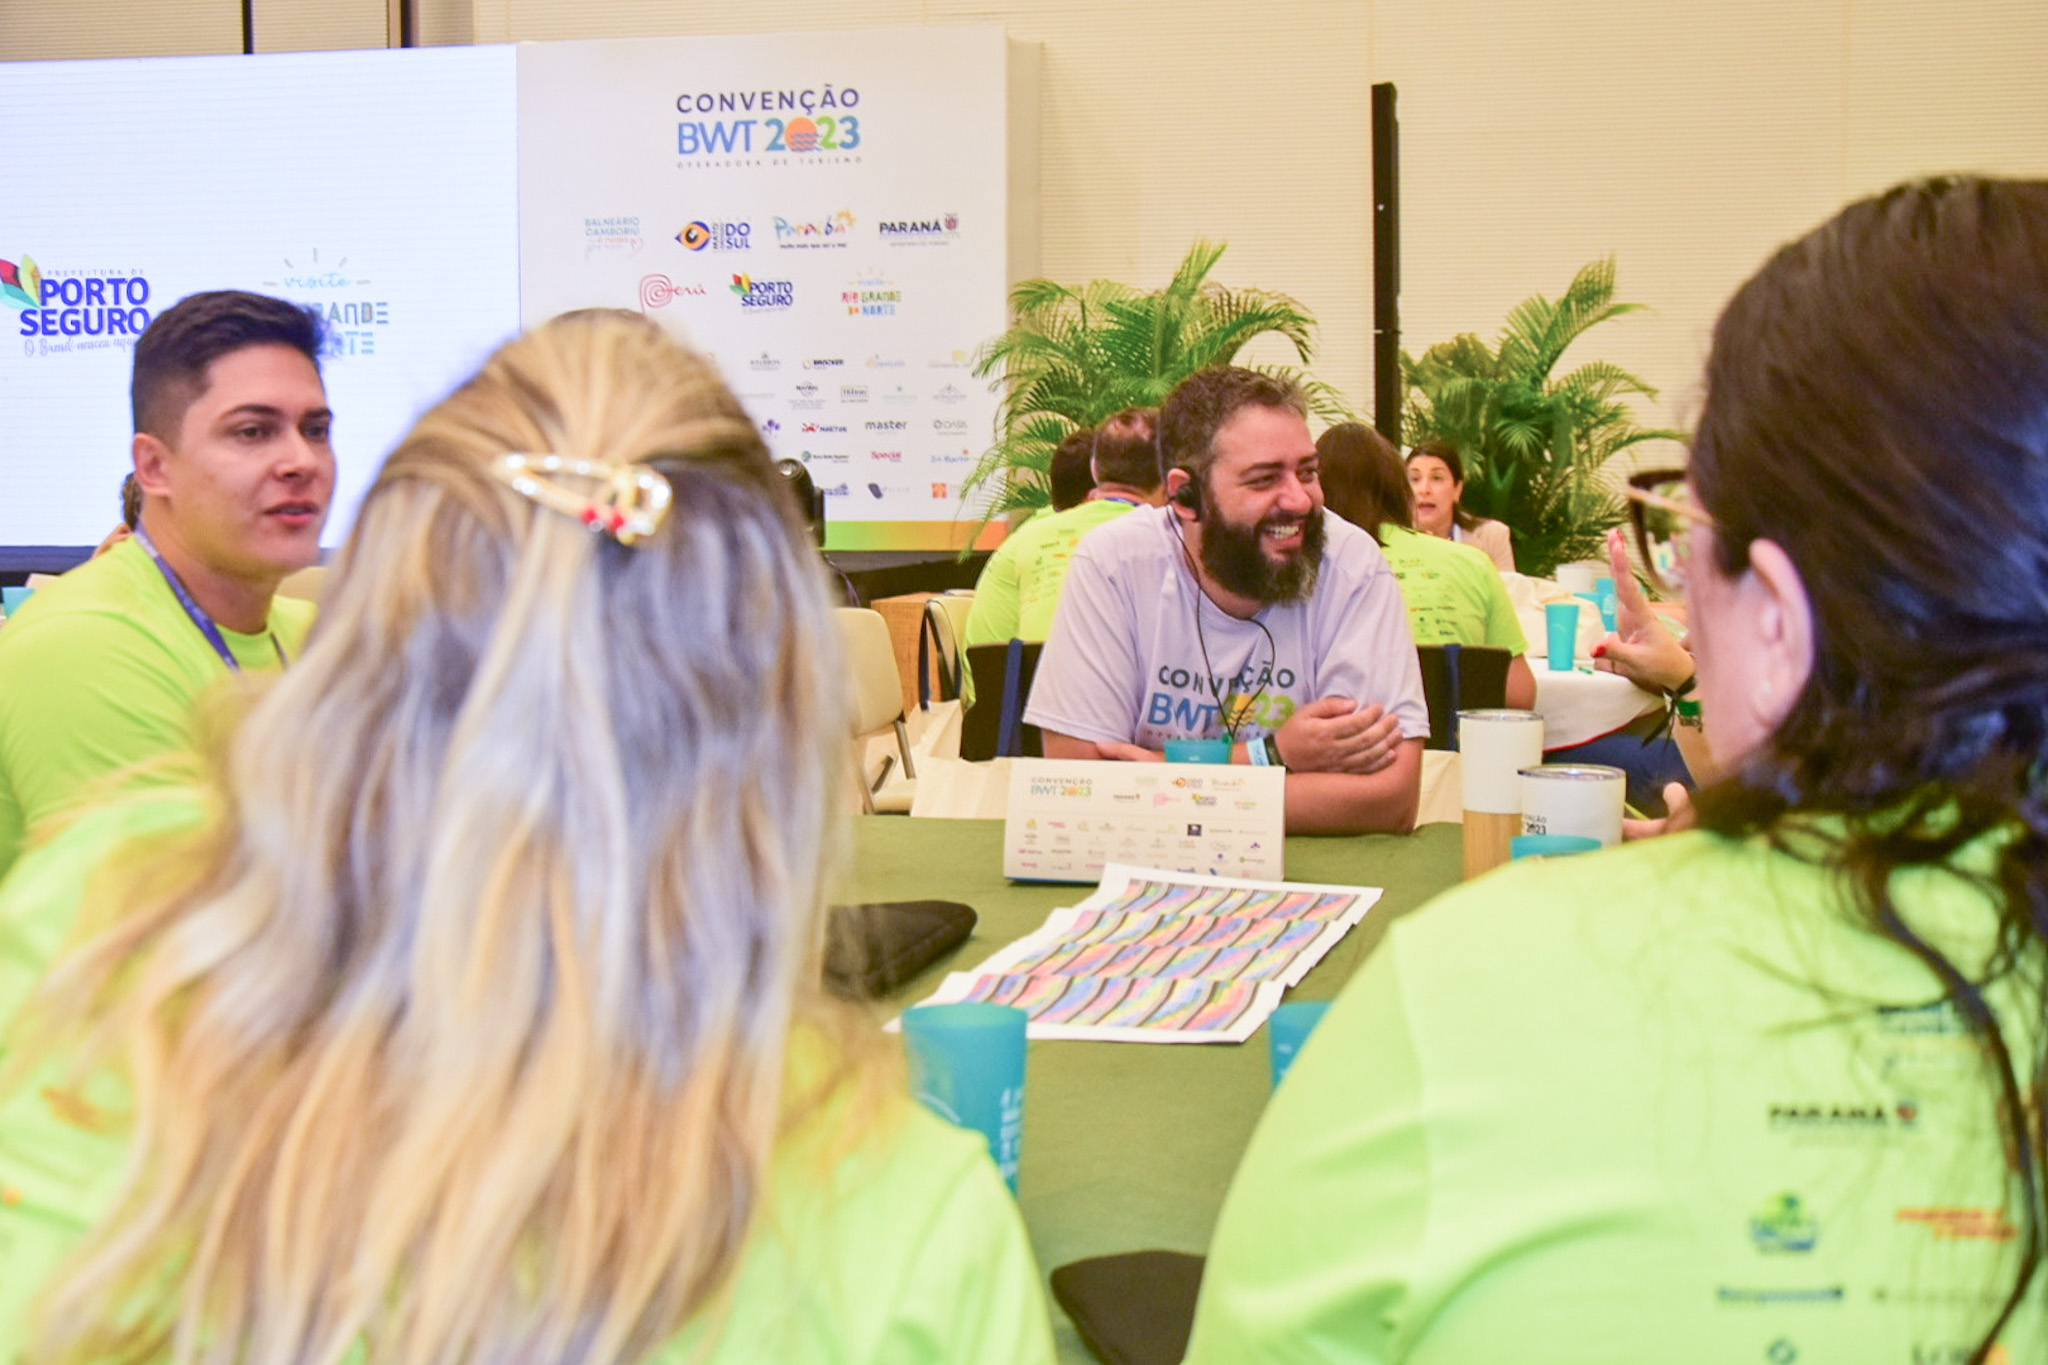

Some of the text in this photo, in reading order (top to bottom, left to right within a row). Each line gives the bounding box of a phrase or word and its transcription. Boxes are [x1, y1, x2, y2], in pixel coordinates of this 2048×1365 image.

[676, 83, 860, 115] CONVENÇÃO
[678, 115, 861, 155] BWT 2023
[677, 156, 863, 169] OPERADORA DE TURISMO
[726, 222, 750, 236] DO
[879, 219, 942, 234] PARANÁ
[726, 237, 751, 249] SUL
[41, 277, 148, 306] PORTO
[750, 281, 794, 295] PORTO
[742, 293, 794, 306] SEGURO
[20, 307, 150, 336] SEGURO
[865, 420, 907, 430] master
